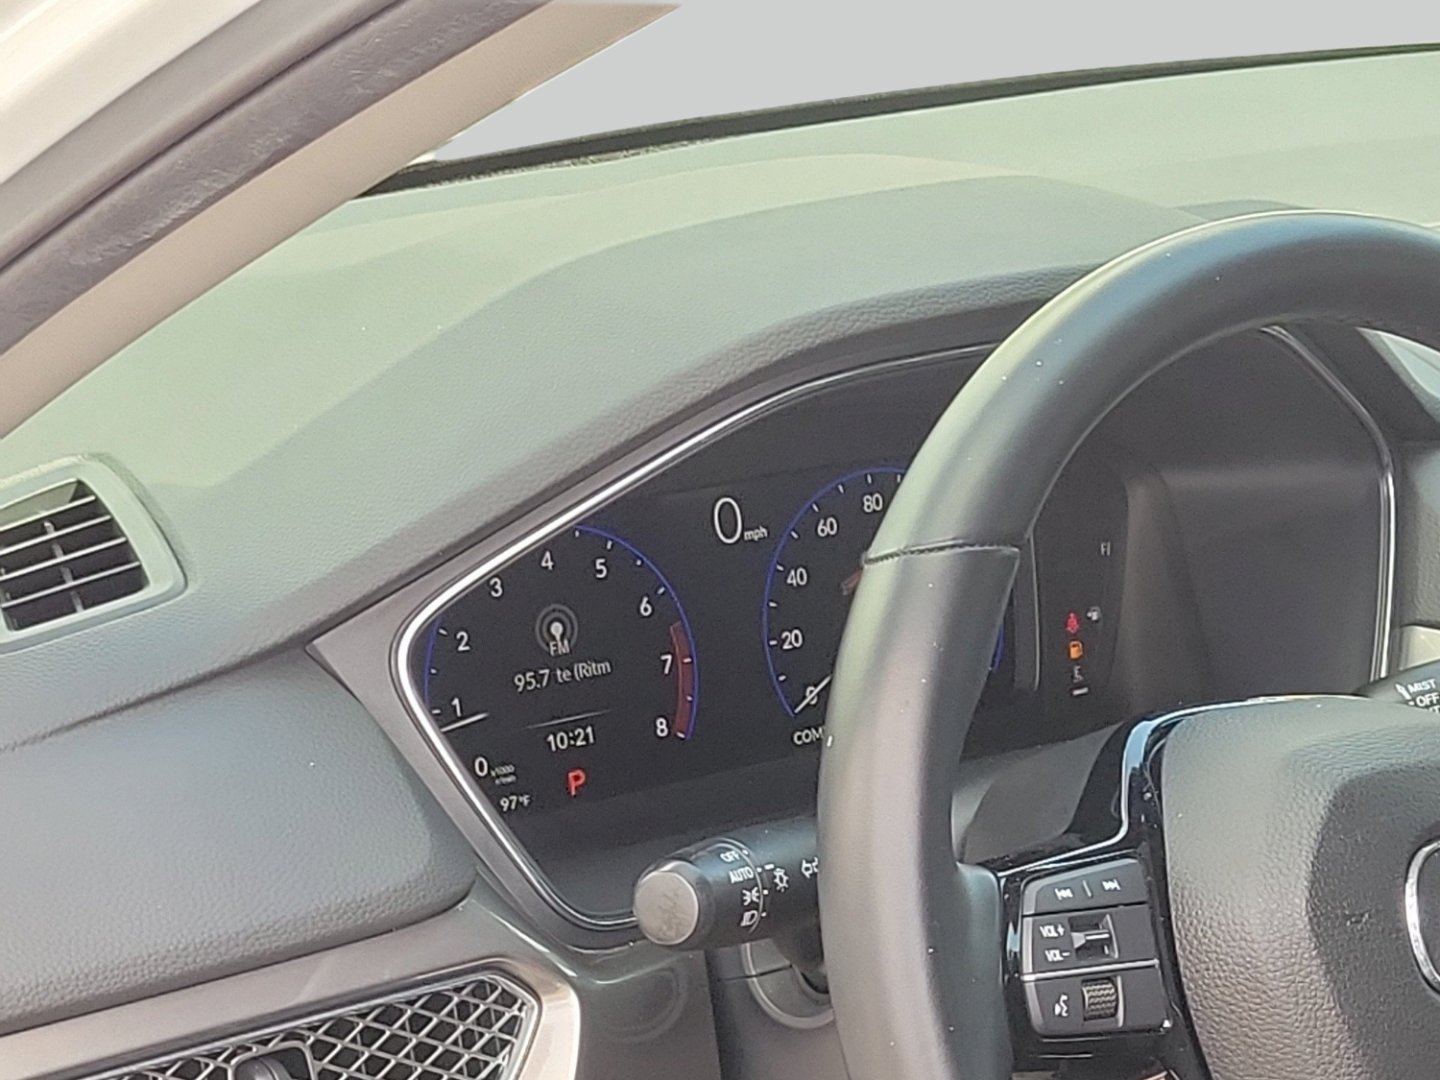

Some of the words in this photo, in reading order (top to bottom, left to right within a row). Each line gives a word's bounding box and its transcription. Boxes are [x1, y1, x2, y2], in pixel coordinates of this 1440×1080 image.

[863, 493, 883, 512] 80
[714, 497, 742, 543] 0
[744, 525, 768, 541] mph
[817, 517, 837, 537] 60
[541, 551, 554, 570] 4
[595, 558, 607, 579] 5
[489, 577, 503, 597] 3
[787, 567, 807, 587] 40
[640, 597, 652, 617] 6
[456, 632, 470, 651] 2
[550, 641, 570, 656] FM
[781, 629, 803, 649] 20
[660, 654, 673, 674] 7
[514, 669, 550, 692] 95.7
[556, 668, 572, 683] te
[574, 661, 611, 681] (Ritm
[1407, 679, 1436, 694] MIST
[452, 698, 462, 717] 1
[1415, 692, 1440, 707] OFF
[656, 718, 668, 737] 8
[547, 726, 595, 751] 10:21
[474, 756, 488, 776] 0
[568, 770, 586, 796] P
[720, 850, 740, 862] OFF
[729, 866, 754, 884] AUTO
